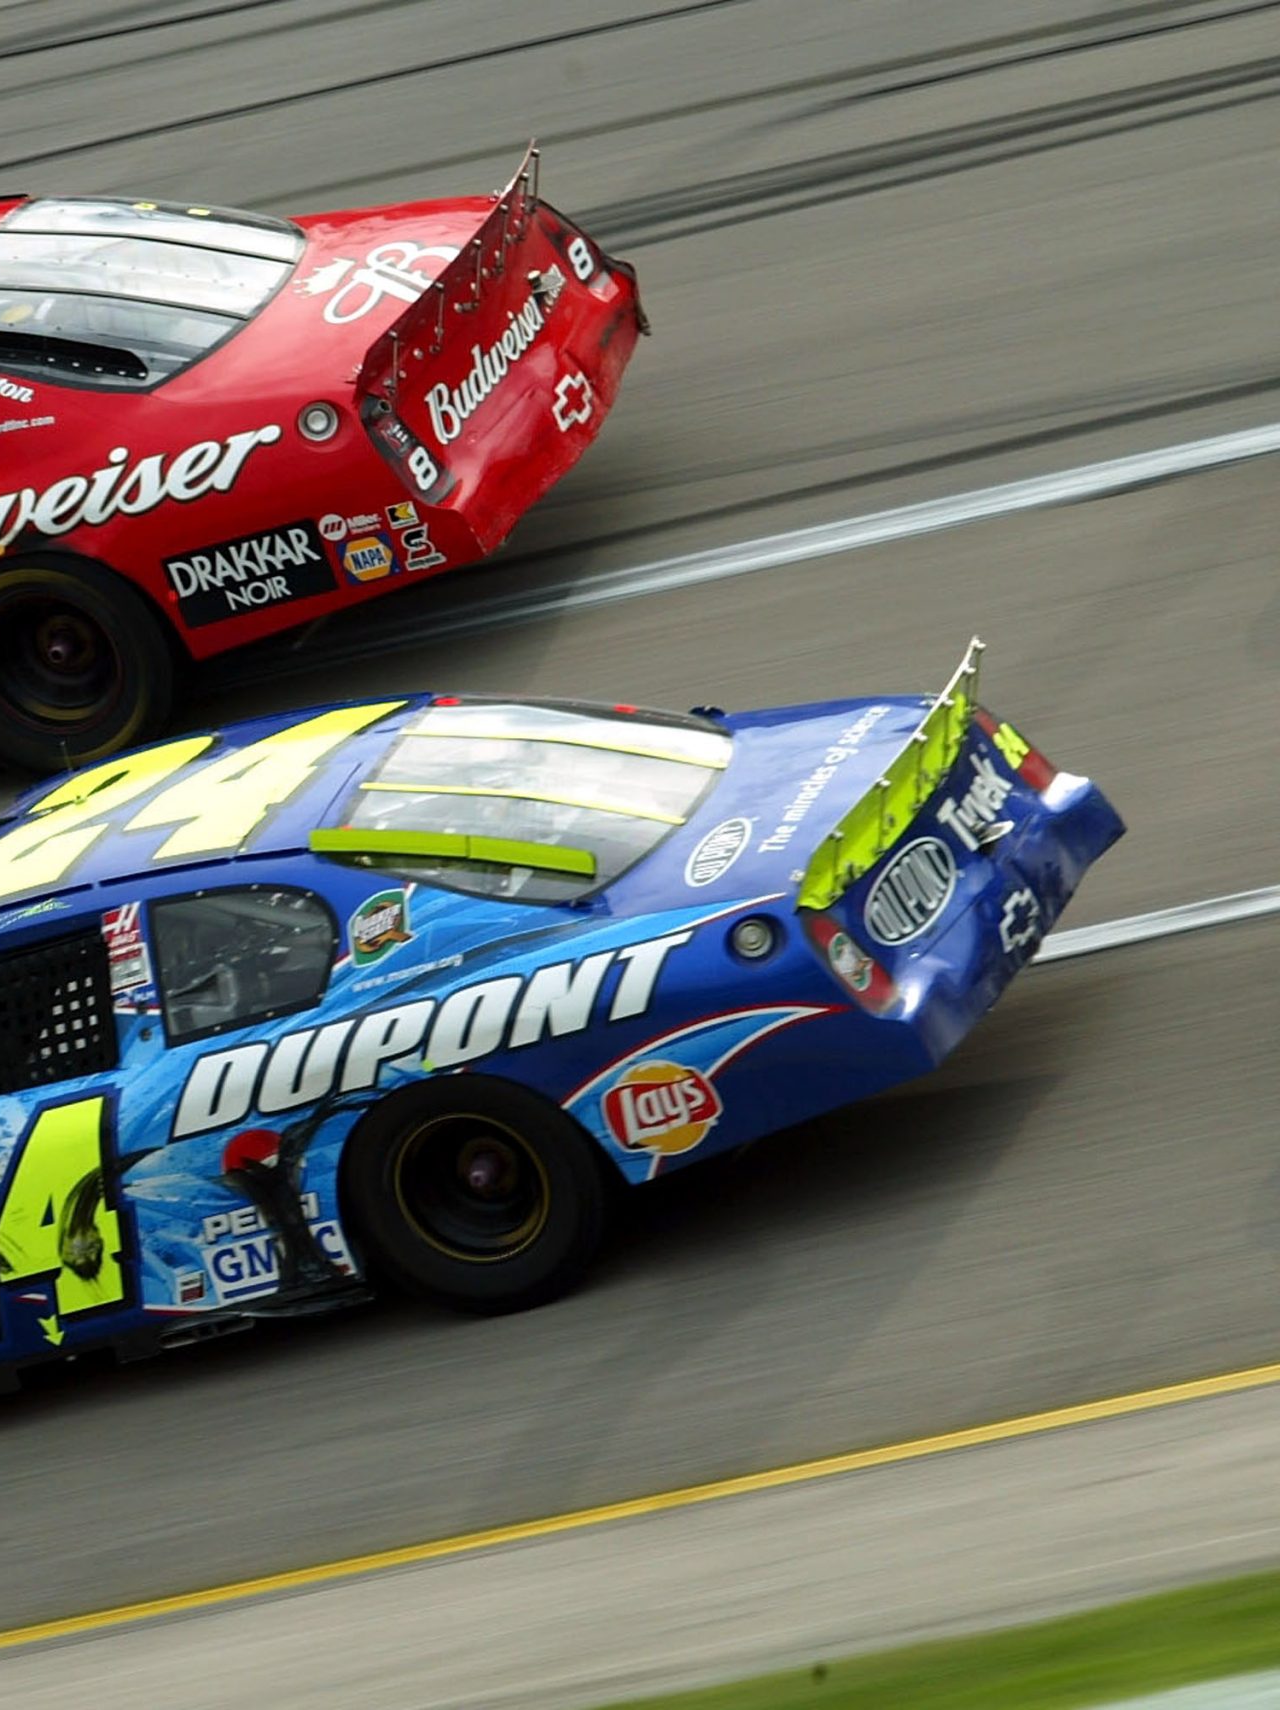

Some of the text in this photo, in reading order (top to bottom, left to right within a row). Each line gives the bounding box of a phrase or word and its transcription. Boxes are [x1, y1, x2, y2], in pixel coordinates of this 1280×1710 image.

[567, 237, 595, 281] 8
[424, 295, 545, 445] Budweiser
[408, 446, 439, 490] 8
[168, 528, 321, 598] DRAKKAR
[351, 547, 387, 571] NAPA
[225, 575, 292, 611] NOIR
[758, 825, 798, 853] The
[782, 765, 838, 822] miracles
[825, 746, 859, 764] of
[172, 930, 694, 1139] DUPONT
